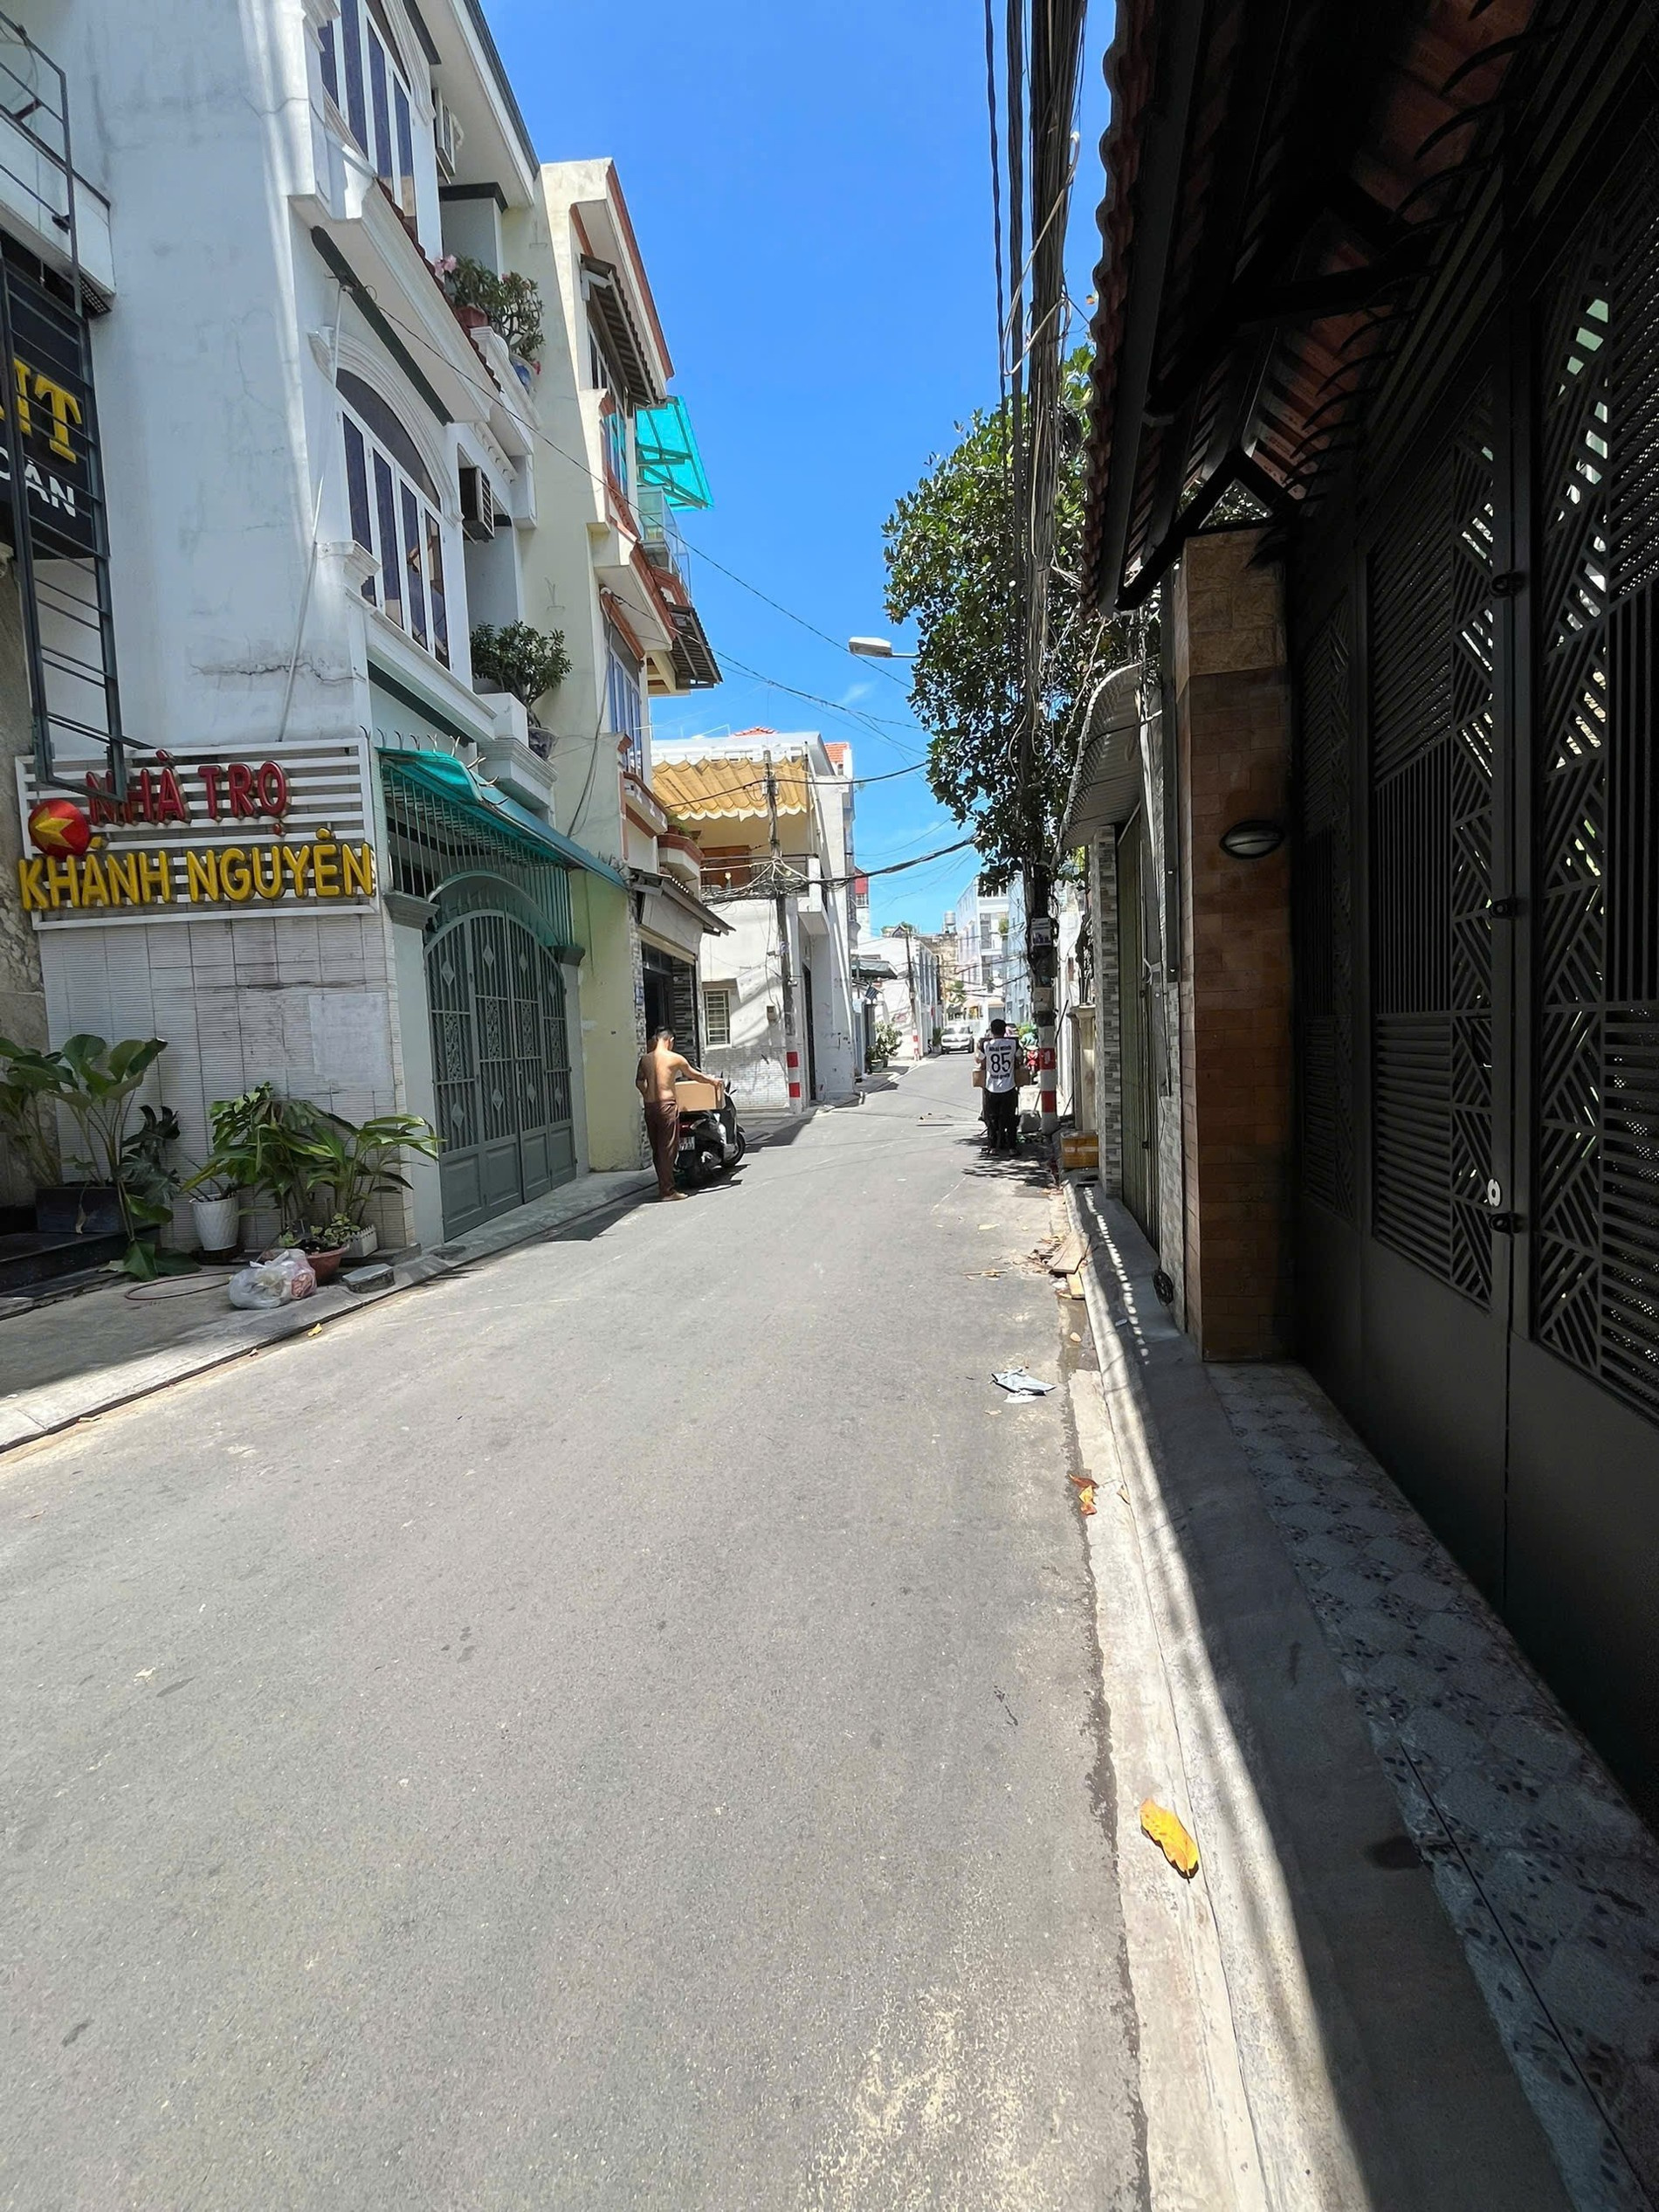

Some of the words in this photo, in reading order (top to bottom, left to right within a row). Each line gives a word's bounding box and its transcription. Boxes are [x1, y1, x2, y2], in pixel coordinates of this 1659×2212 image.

[86, 748, 189, 826] NHÀ
[198, 760, 289, 836] TRỌ
[18, 836, 173, 910] KHÁNH
[186, 826, 375, 902] NGUYÊN
[990, 1051, 1011, 1073] 85
